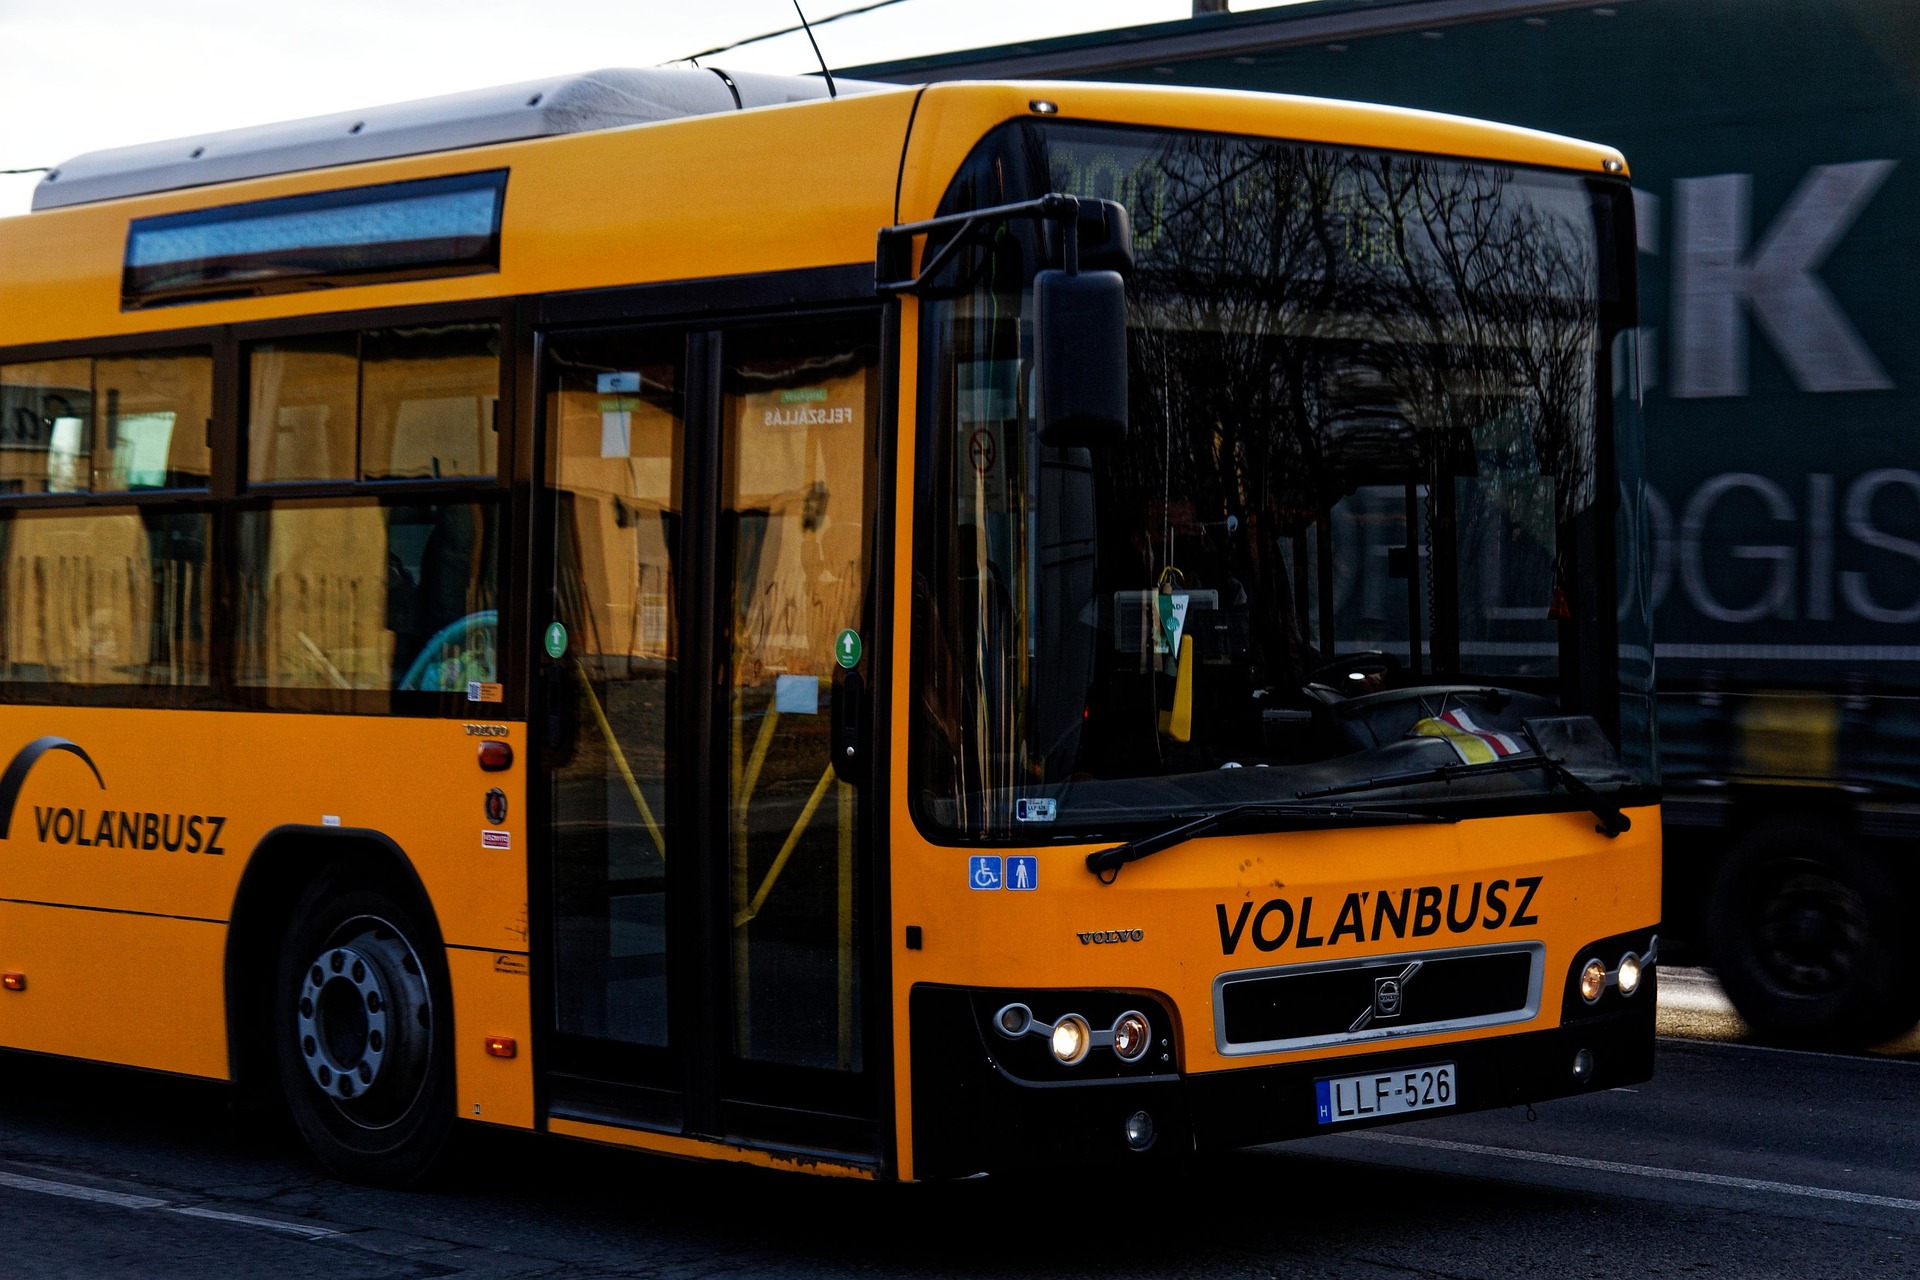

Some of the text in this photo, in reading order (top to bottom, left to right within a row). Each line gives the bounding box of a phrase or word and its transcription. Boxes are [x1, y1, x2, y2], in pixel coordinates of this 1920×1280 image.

[1632, 159, 1900, 399] K
[1077, 929, 1144, 944] VOLVO
[1216, 876, 1543, 955] VOLÁNBUSZ
[1320, 1069, 1450, 1117] H LLF-526
